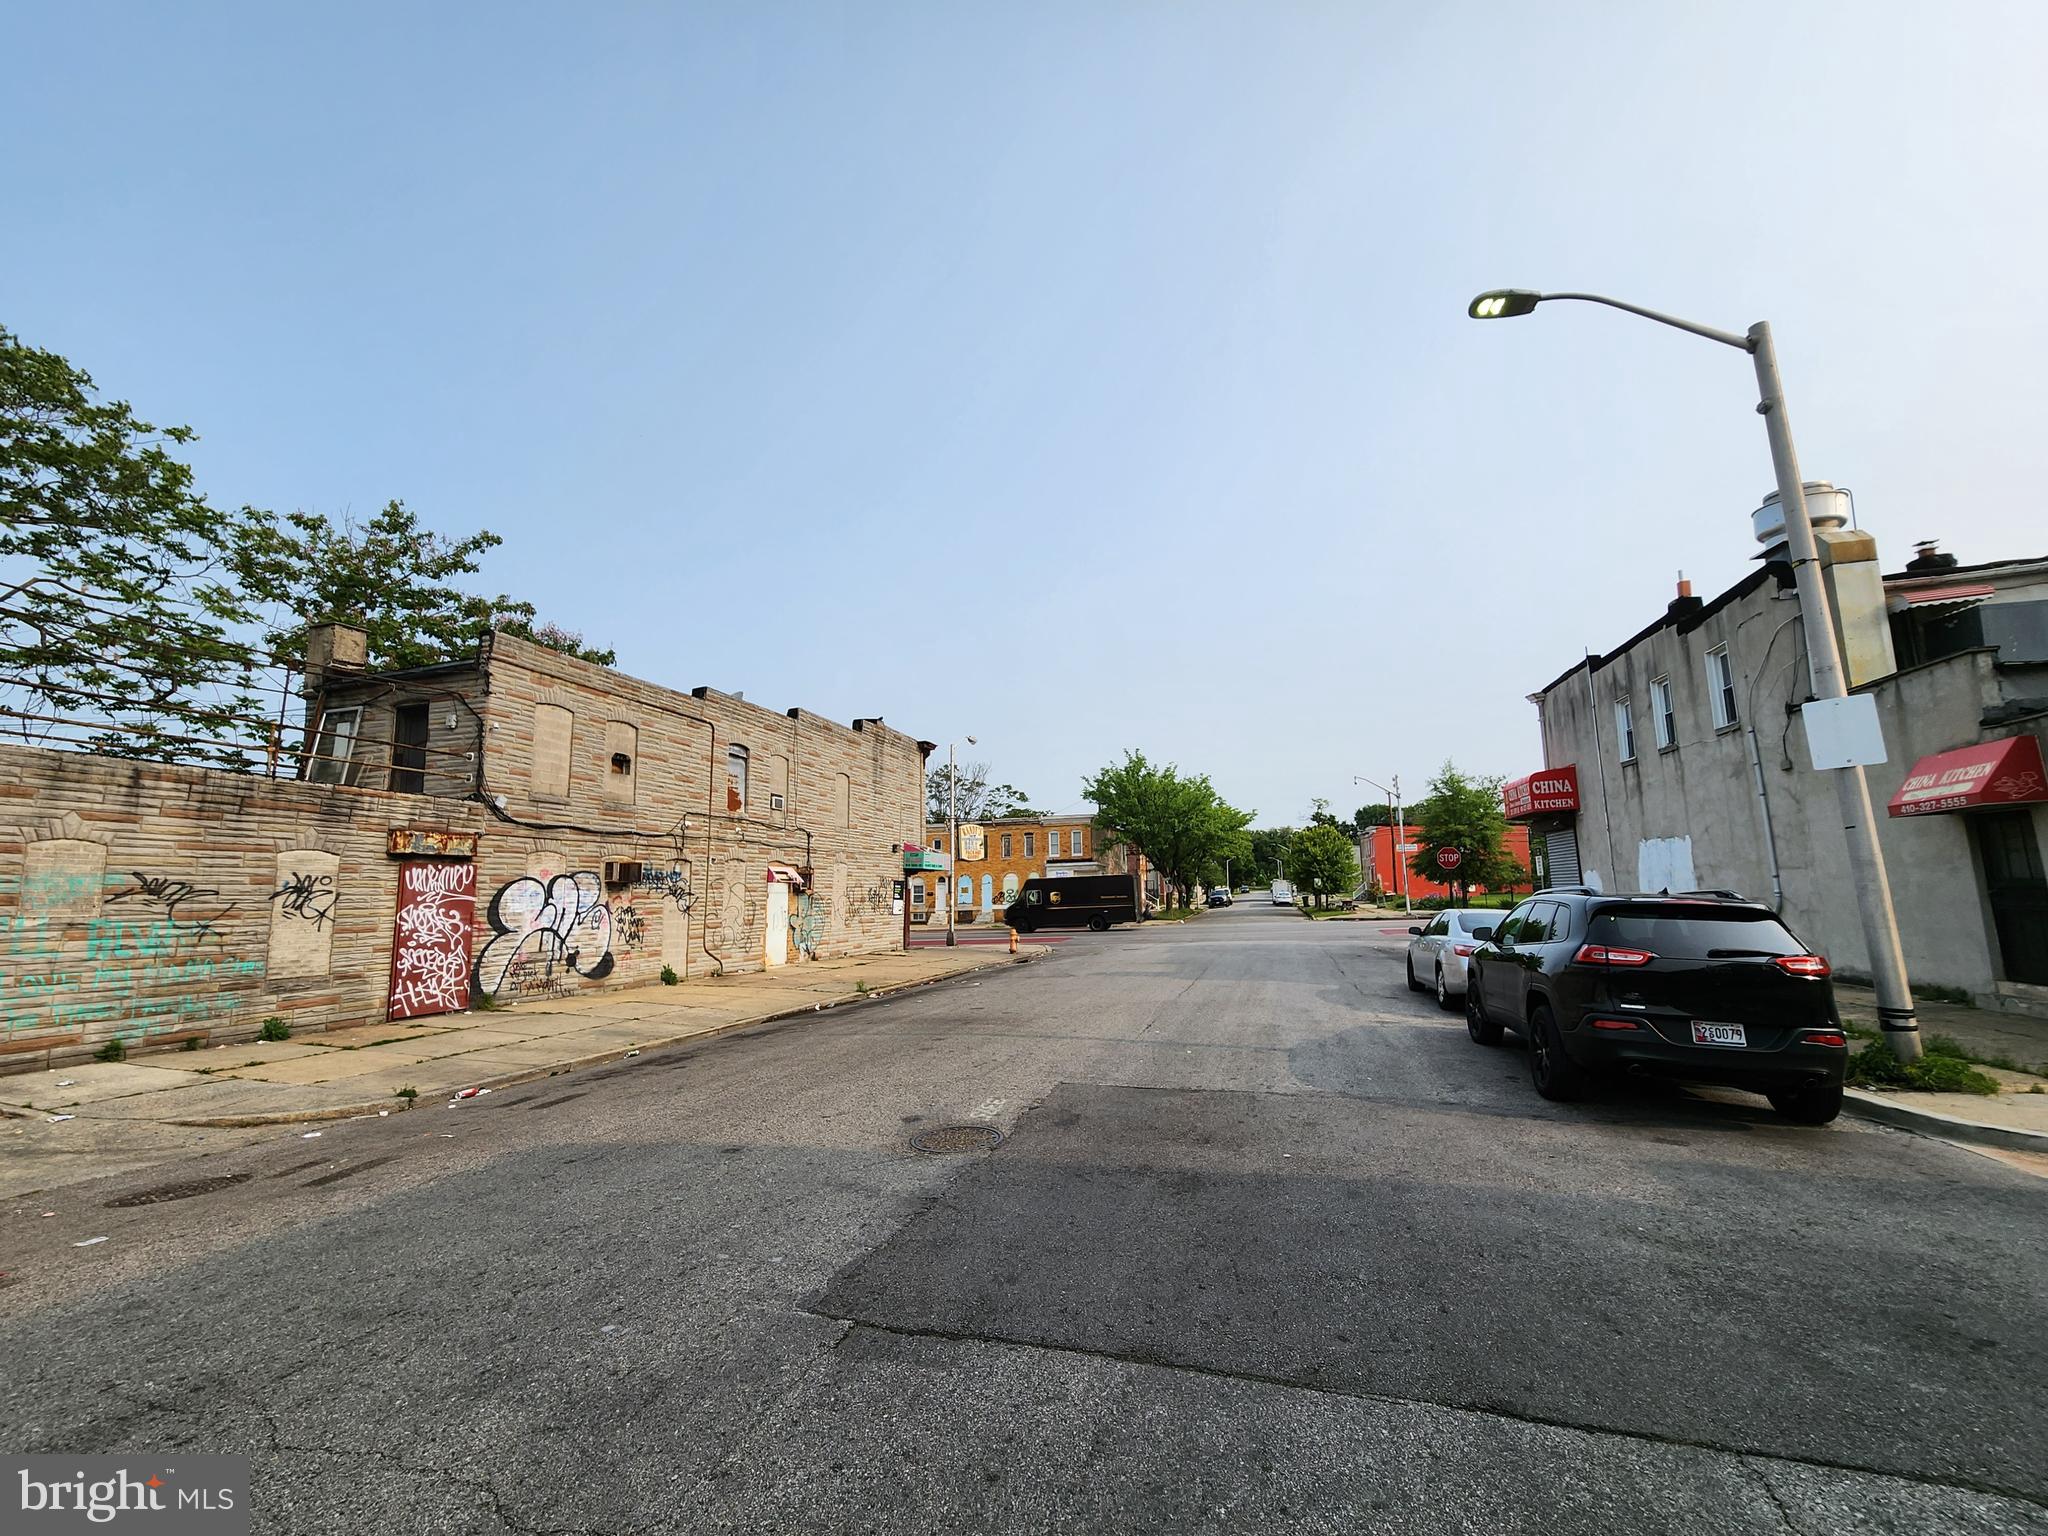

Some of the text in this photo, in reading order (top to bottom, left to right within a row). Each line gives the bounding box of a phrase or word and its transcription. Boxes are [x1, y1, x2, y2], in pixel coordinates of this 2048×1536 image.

[1902, 774, 1937, 792] CHINA
[1938, 761, 1997, 785] KITCHEN
[1532, 779, 1573, 794] CHINA
[1533, 798, 1575, 810] KITCHEN
[1900, 797, 1968, 814] 410-327-5555
[1439, 853, 1459, 862] STOP
